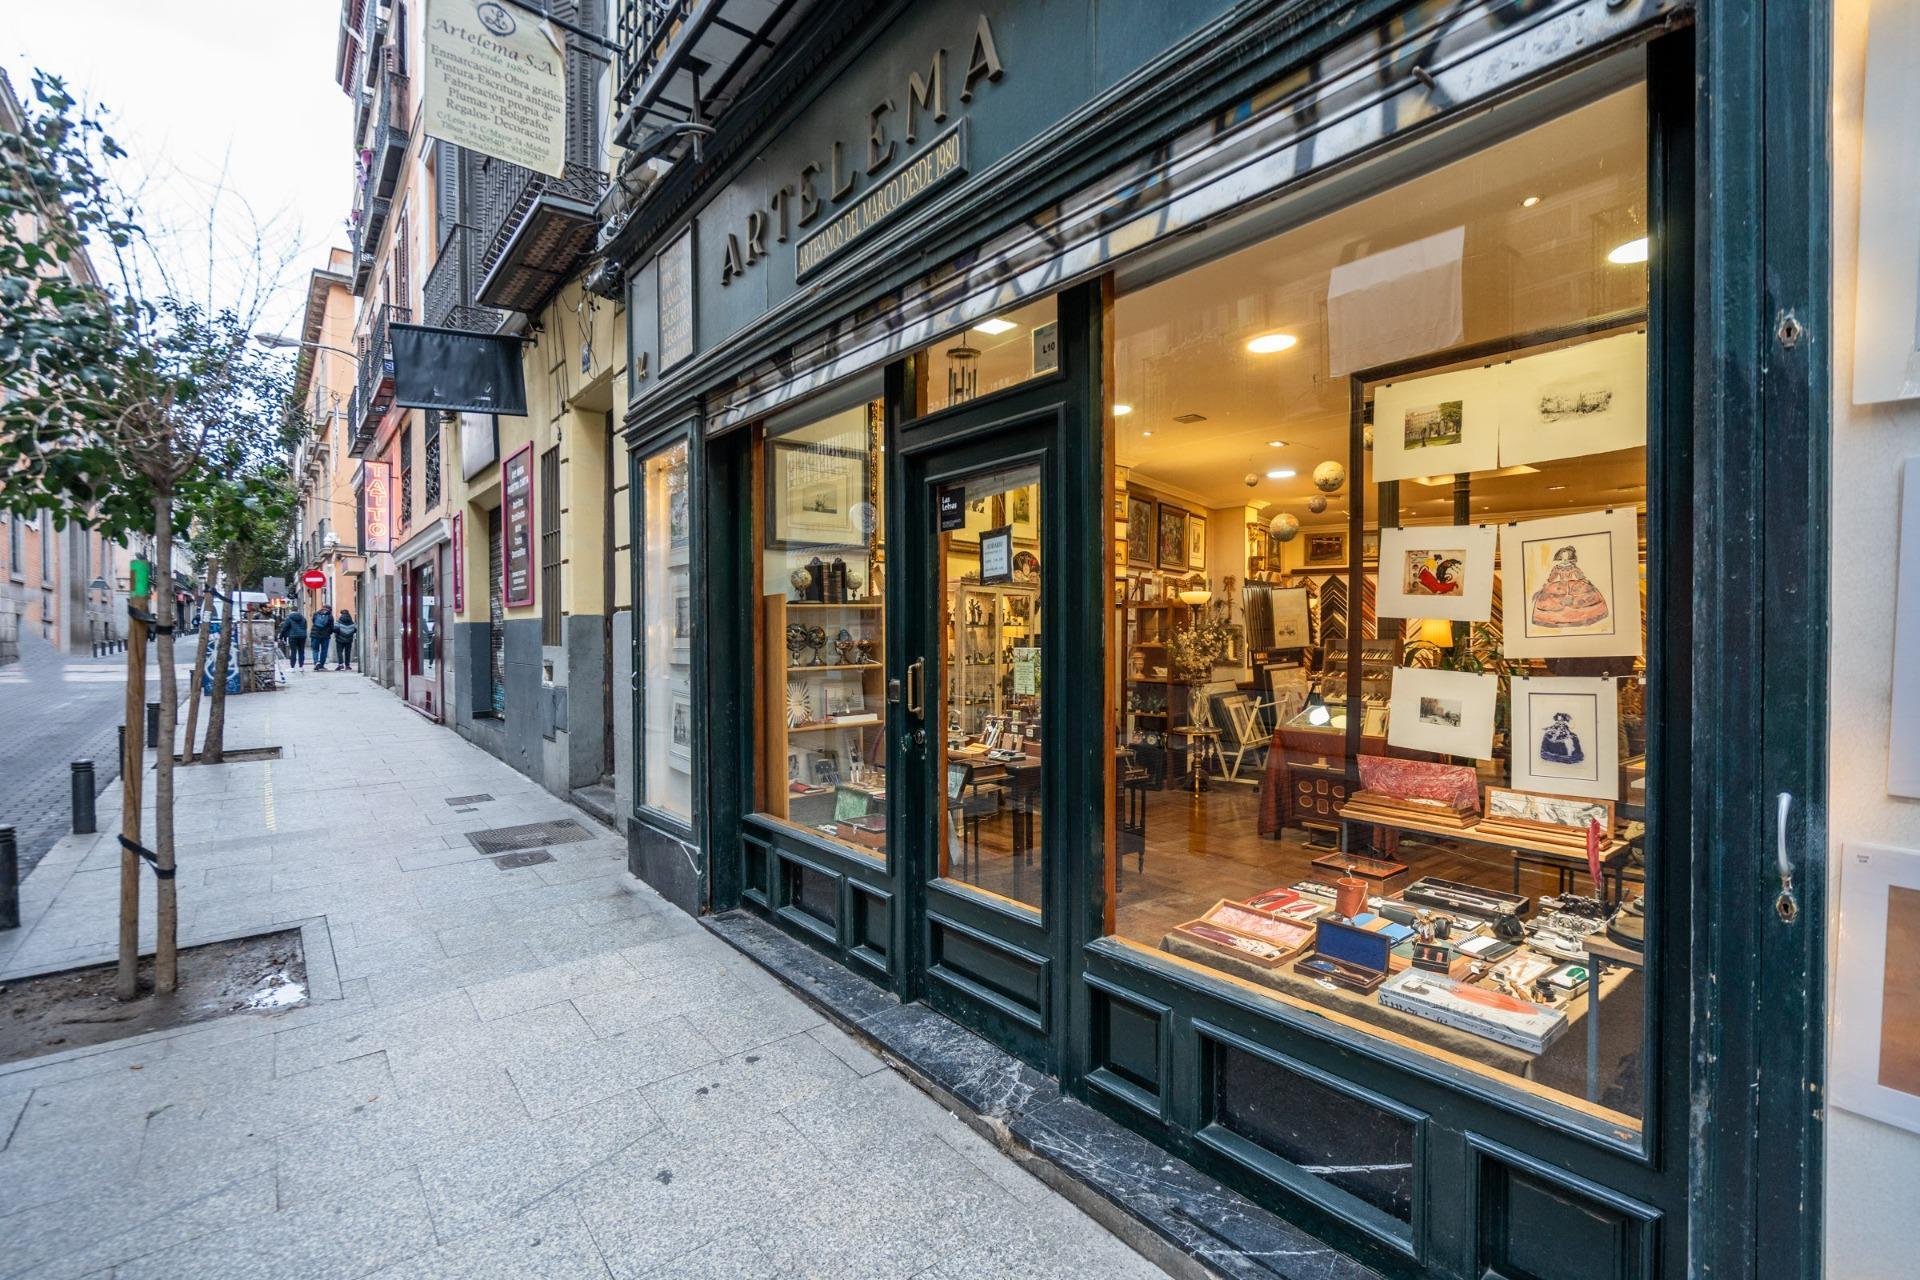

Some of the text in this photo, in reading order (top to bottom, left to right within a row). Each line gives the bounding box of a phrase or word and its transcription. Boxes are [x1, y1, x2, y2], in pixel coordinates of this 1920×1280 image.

[431, 19, 557, 77] Artelema S.A.
[471, 46, 530, 76] Desde 1980
[444, 72, 554, 122] Fabricación propia de
[449, 87, 489, 110] Plumas
[490, 104, 497, 114] y
[526, 95, 561, 114] antigua
[494, 115, 551, 145] Decoración
[719, 13, 1006, 287] ARTELEMA
[799, 134, 960, 273] ARTESANOS DEL MARCO DESDE 1980
[1042, 341, 1056, 354] L10
